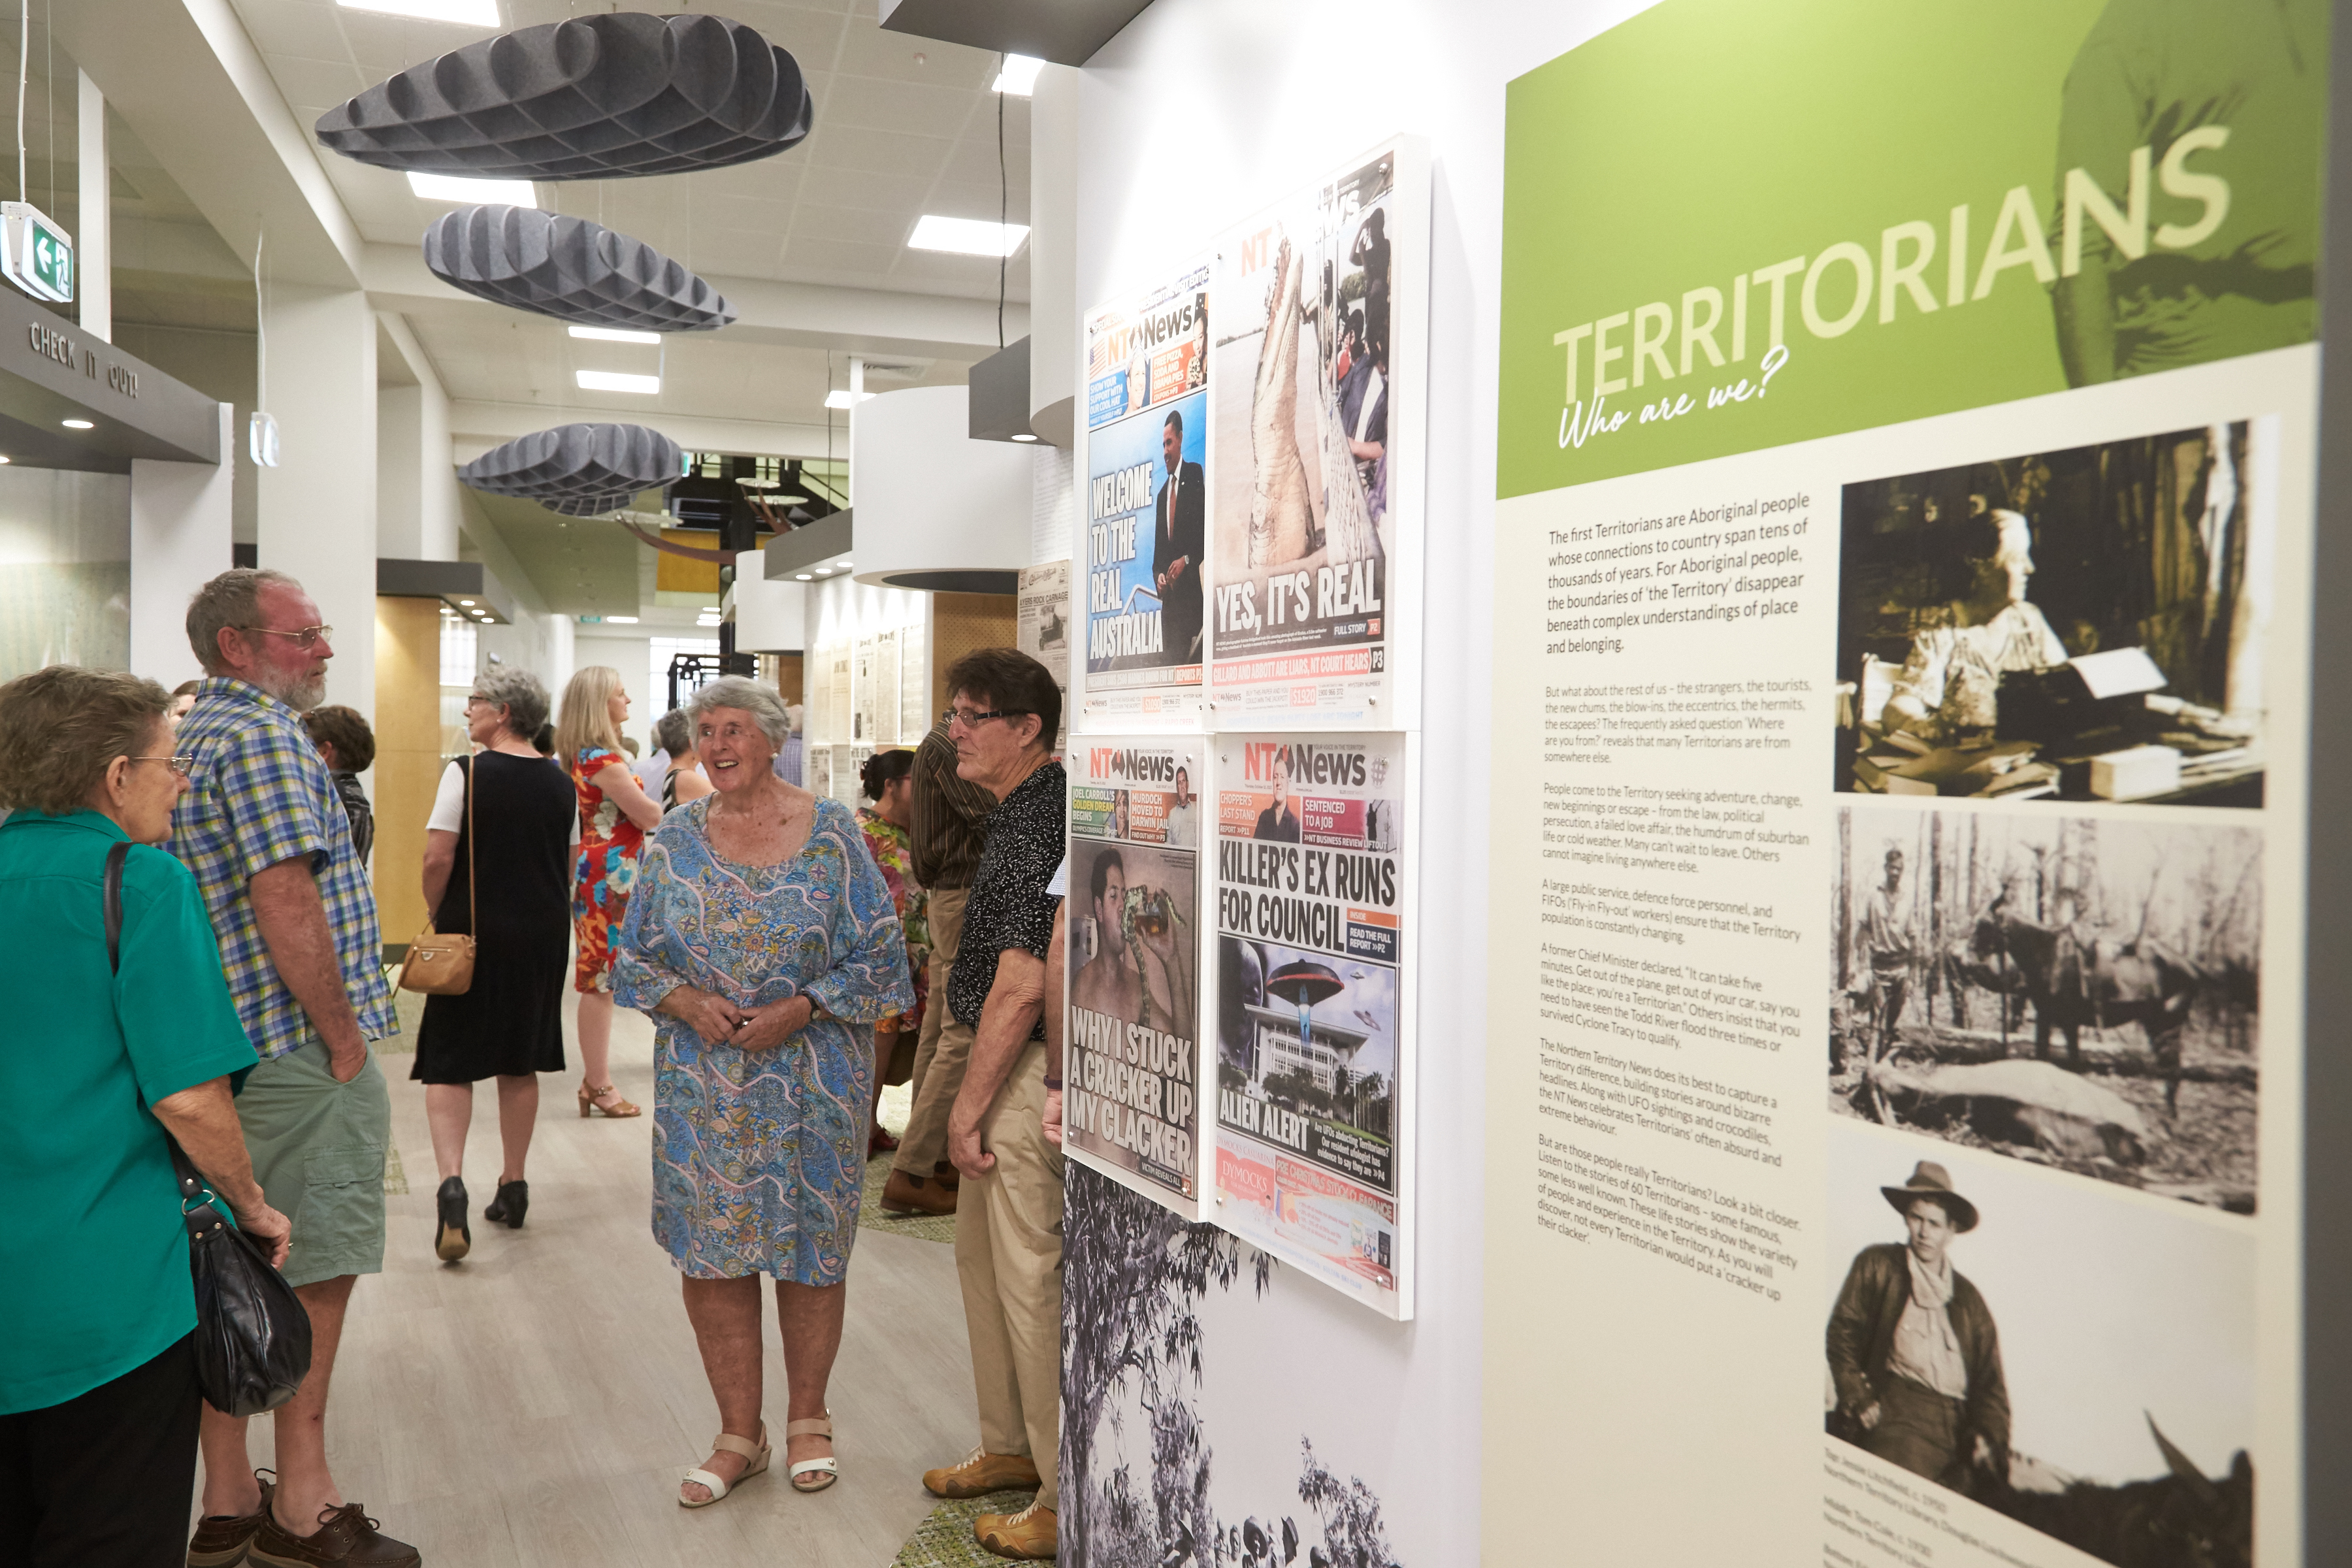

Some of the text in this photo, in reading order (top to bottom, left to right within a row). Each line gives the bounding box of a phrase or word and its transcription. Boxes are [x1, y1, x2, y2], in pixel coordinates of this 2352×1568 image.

[1242, 227, 1272, 278] NT
[1554, 126, 2230, 405] TERRITORIANS
[1108, 328, 1130, 365] NT
[1145, 304, 1192, 350] News
[30, 321, 138, 398] CHECK IT OUT!
[1154, 348, 1183, 368] FREE PIZZA,
[1154, 361, 1179, 378] SODA AND
[1090, 376, 1117, 392] SHOW YOUR
[1090, 384, 1122, 405] SUPPORT WITH
[1154, 370, 1184, 390] OBAMA PIES
[1090, 396, 1120, 415] OUR COOL HAT
[1559, 344, 1789, 448] Who are we?
[1093, 462, 1152, 519] WELCOME
[1549, 492, 1810, 545] The first Territorians are Aboriginal people
[1092, 515, 1135, 566] TO THE
[1548, 517, 1808, 567] whose connections to country span tens of
[1548, 546, 1802, 589] thousands of years. For Aboriginal people,
[1020, 591, 1068, 606] AYERS ROCK CARNAGE
[1091, 569, 1122, 613] REAL
[1216, 559, 1380, 635] YES, IT'S REAL
[1548, 574, 1805, 611] the boundaries of 'the Territory' disappear
[1334, 623, 1378, 636] FULL STORY P2
[1547, 598, 1799, 632] beneath complex understandings of place
[1090, 610, 1163, 659] AUSTRALIA
[1546, 636, 1624, 655] and belonging.
[1213, 651, 1383, 682] GILLARD AND ABBOTT ARE LIARS, NT COURT HEARS P3
[1090, 748, 1174, 781] NT News
[1245, 743, 1365, 786] NT News
[1073, 789, 1115, 802] JOEL CARROLL'S
[1073, 800, 1114, 812] GOLDEN DREAM
[1132, 792, 1162, 804] MURDOCH
[1132, 804, 1162, 817] MOVED TO
[1220, 793, 1252, 806] CHOPPER'S
[1305, 800, 1345, 814] SENTENCED
[1073, 811, 1092, 822] BEGINS
[1132, 817, 1169, 830] DARWIN JAIL
[1220, 809, 1255, 821] LAST STAND
[1305, 815, 1333, 830] TO A JOB
[1317, 835, 1341, 845] BUSINESS
[1341, 838, 1363, 847] REVIEW
[1364, 840, 1387, 849] LIFTOUT
[1220, 840, 1396, 907] KILLER'S EX RUNS
[1219, 887, 1344, 952] FOR COUNCIL
[1350, 911, 1366, 921] INSIDE
[1350, 928, 1392, 943] READ THE FULL
[1350, 938, 1371, 950] REPORT
[1541, 942, 1548, 953] A
[1548, 943, 1577, 960] former
[1578, 948, 1601, 966] Chief
[1602, 952, 1639, 970] Minister
[1699, 972, 1716, 984] can
[1718, 973, 1740, 988] take
[1742, 976, 1762, 992] five
[1072, 1005, 1191, 1083] WHY I STUCK
[1070, 1047, 1192, 1127] A CRACKER UP
[1071, 1087, 1191, 1175] MY CLACKER
[1220, 1088, 1309, 1151] ALIEN ALERT
[1323, 1124, 1335, 1137] UFOs
[1335, 1130, 1358, 1149] abducting
[1359, 1137, 1389, 1157] Territorians?
[1331, 1139, 1349, 1155] resident
[1350, 1147, 1371, 1164] ufologist
[1372, 1154, 1380, 1168] has
[1142, 1162, 1155, 1175] VICTIM
[1155, 1169, 1172, 1183] REVEALS
[1223, 1160, 1267, 1192] DYMOCKS
